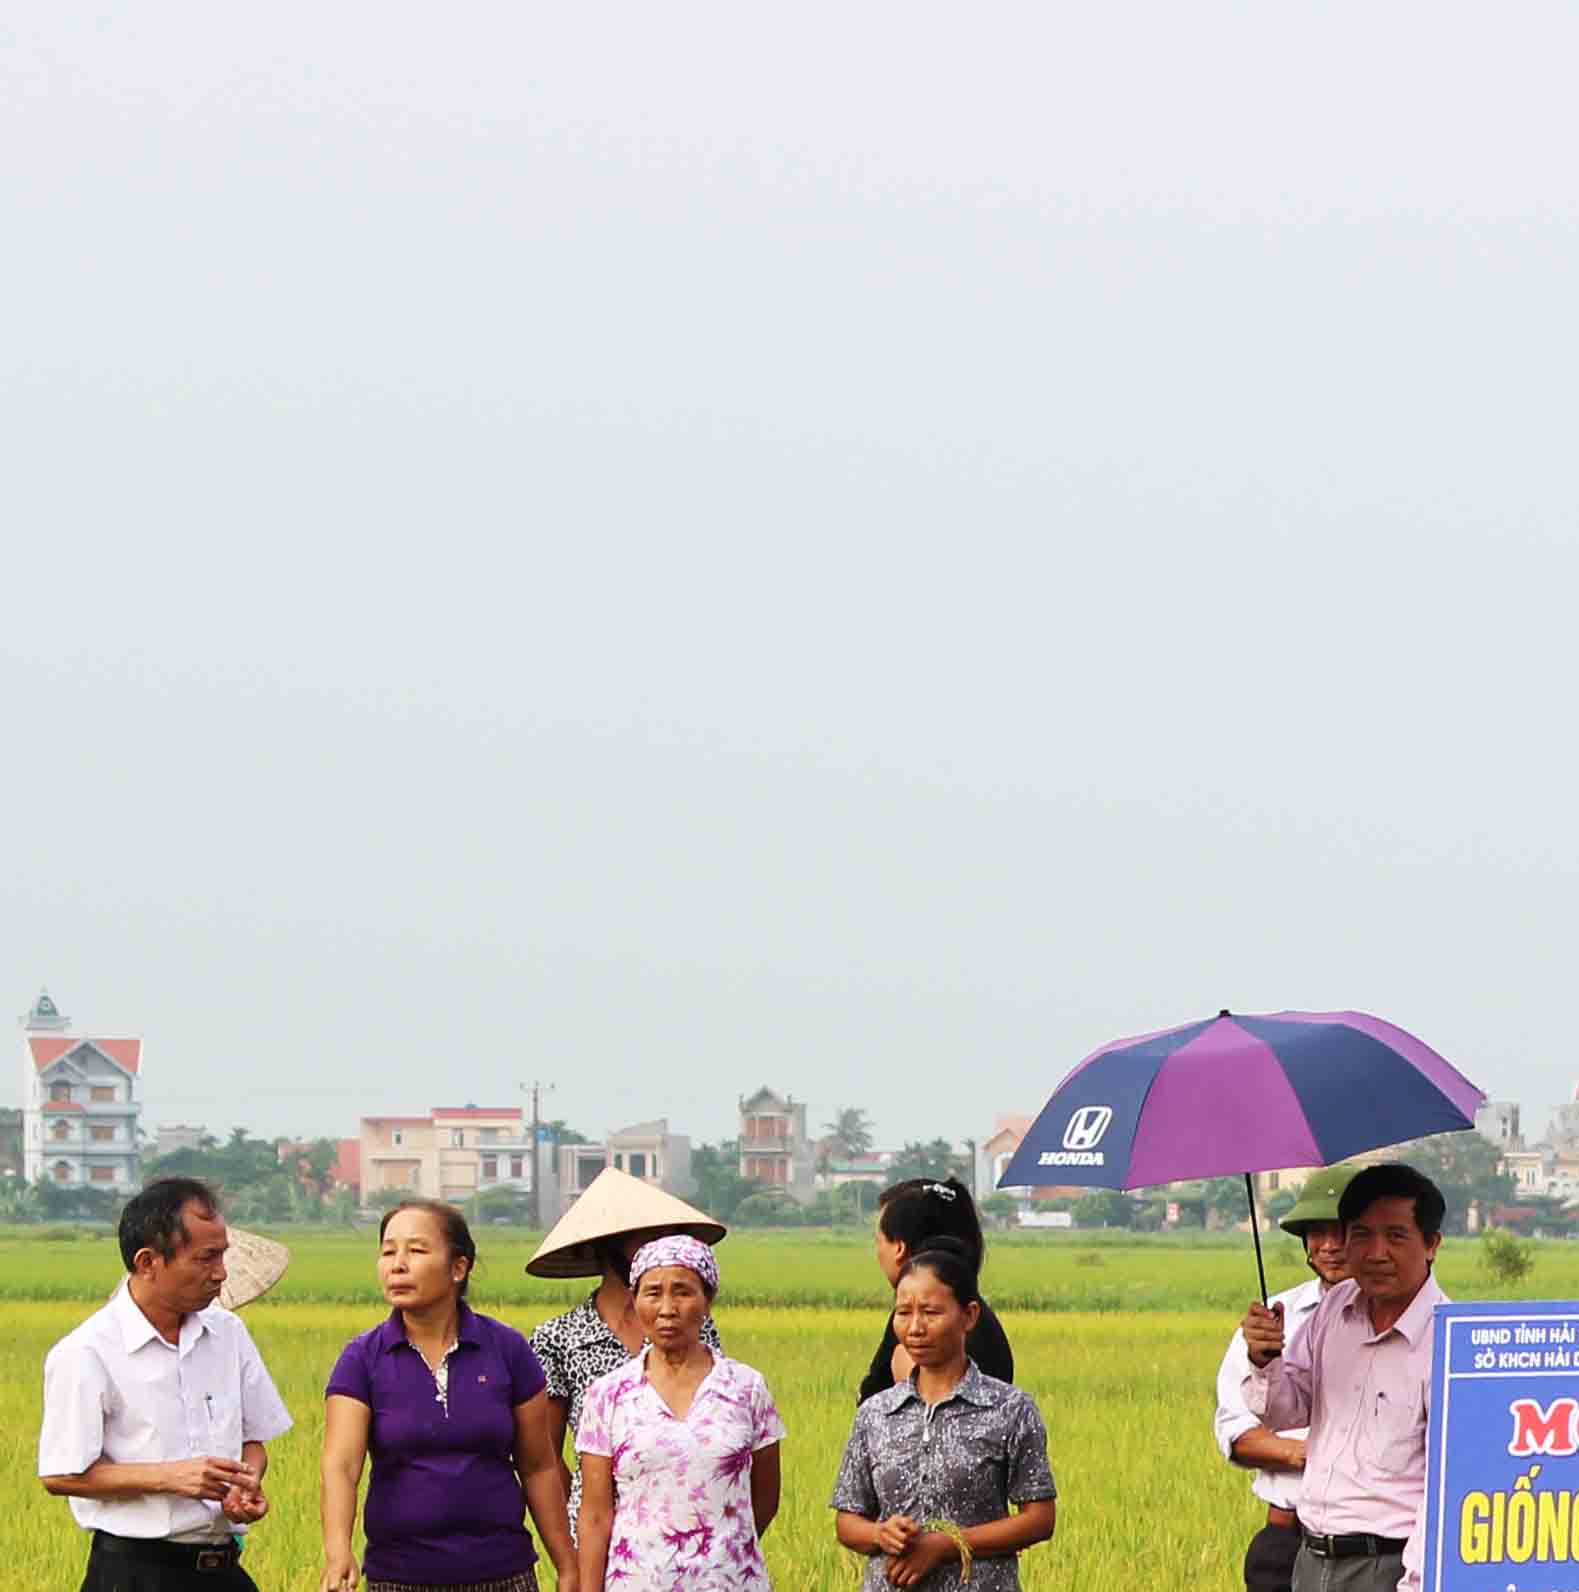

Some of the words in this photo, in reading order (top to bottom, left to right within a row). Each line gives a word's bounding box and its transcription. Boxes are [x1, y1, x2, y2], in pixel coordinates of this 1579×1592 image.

[1038, 1152, 1104, 1166] HONDA
[1472, 1328, 1511, 1344] UBND
[1514, 1322, 1546, 1343] TỈNH
[1550, 1322, 1574, 1343] HẢI
[1475, 1347, 1496, 1368] SỞ
[1499, 1352, 1541, 1368] KHCN
[1544, 1346, 1569, 1367] HẢI
